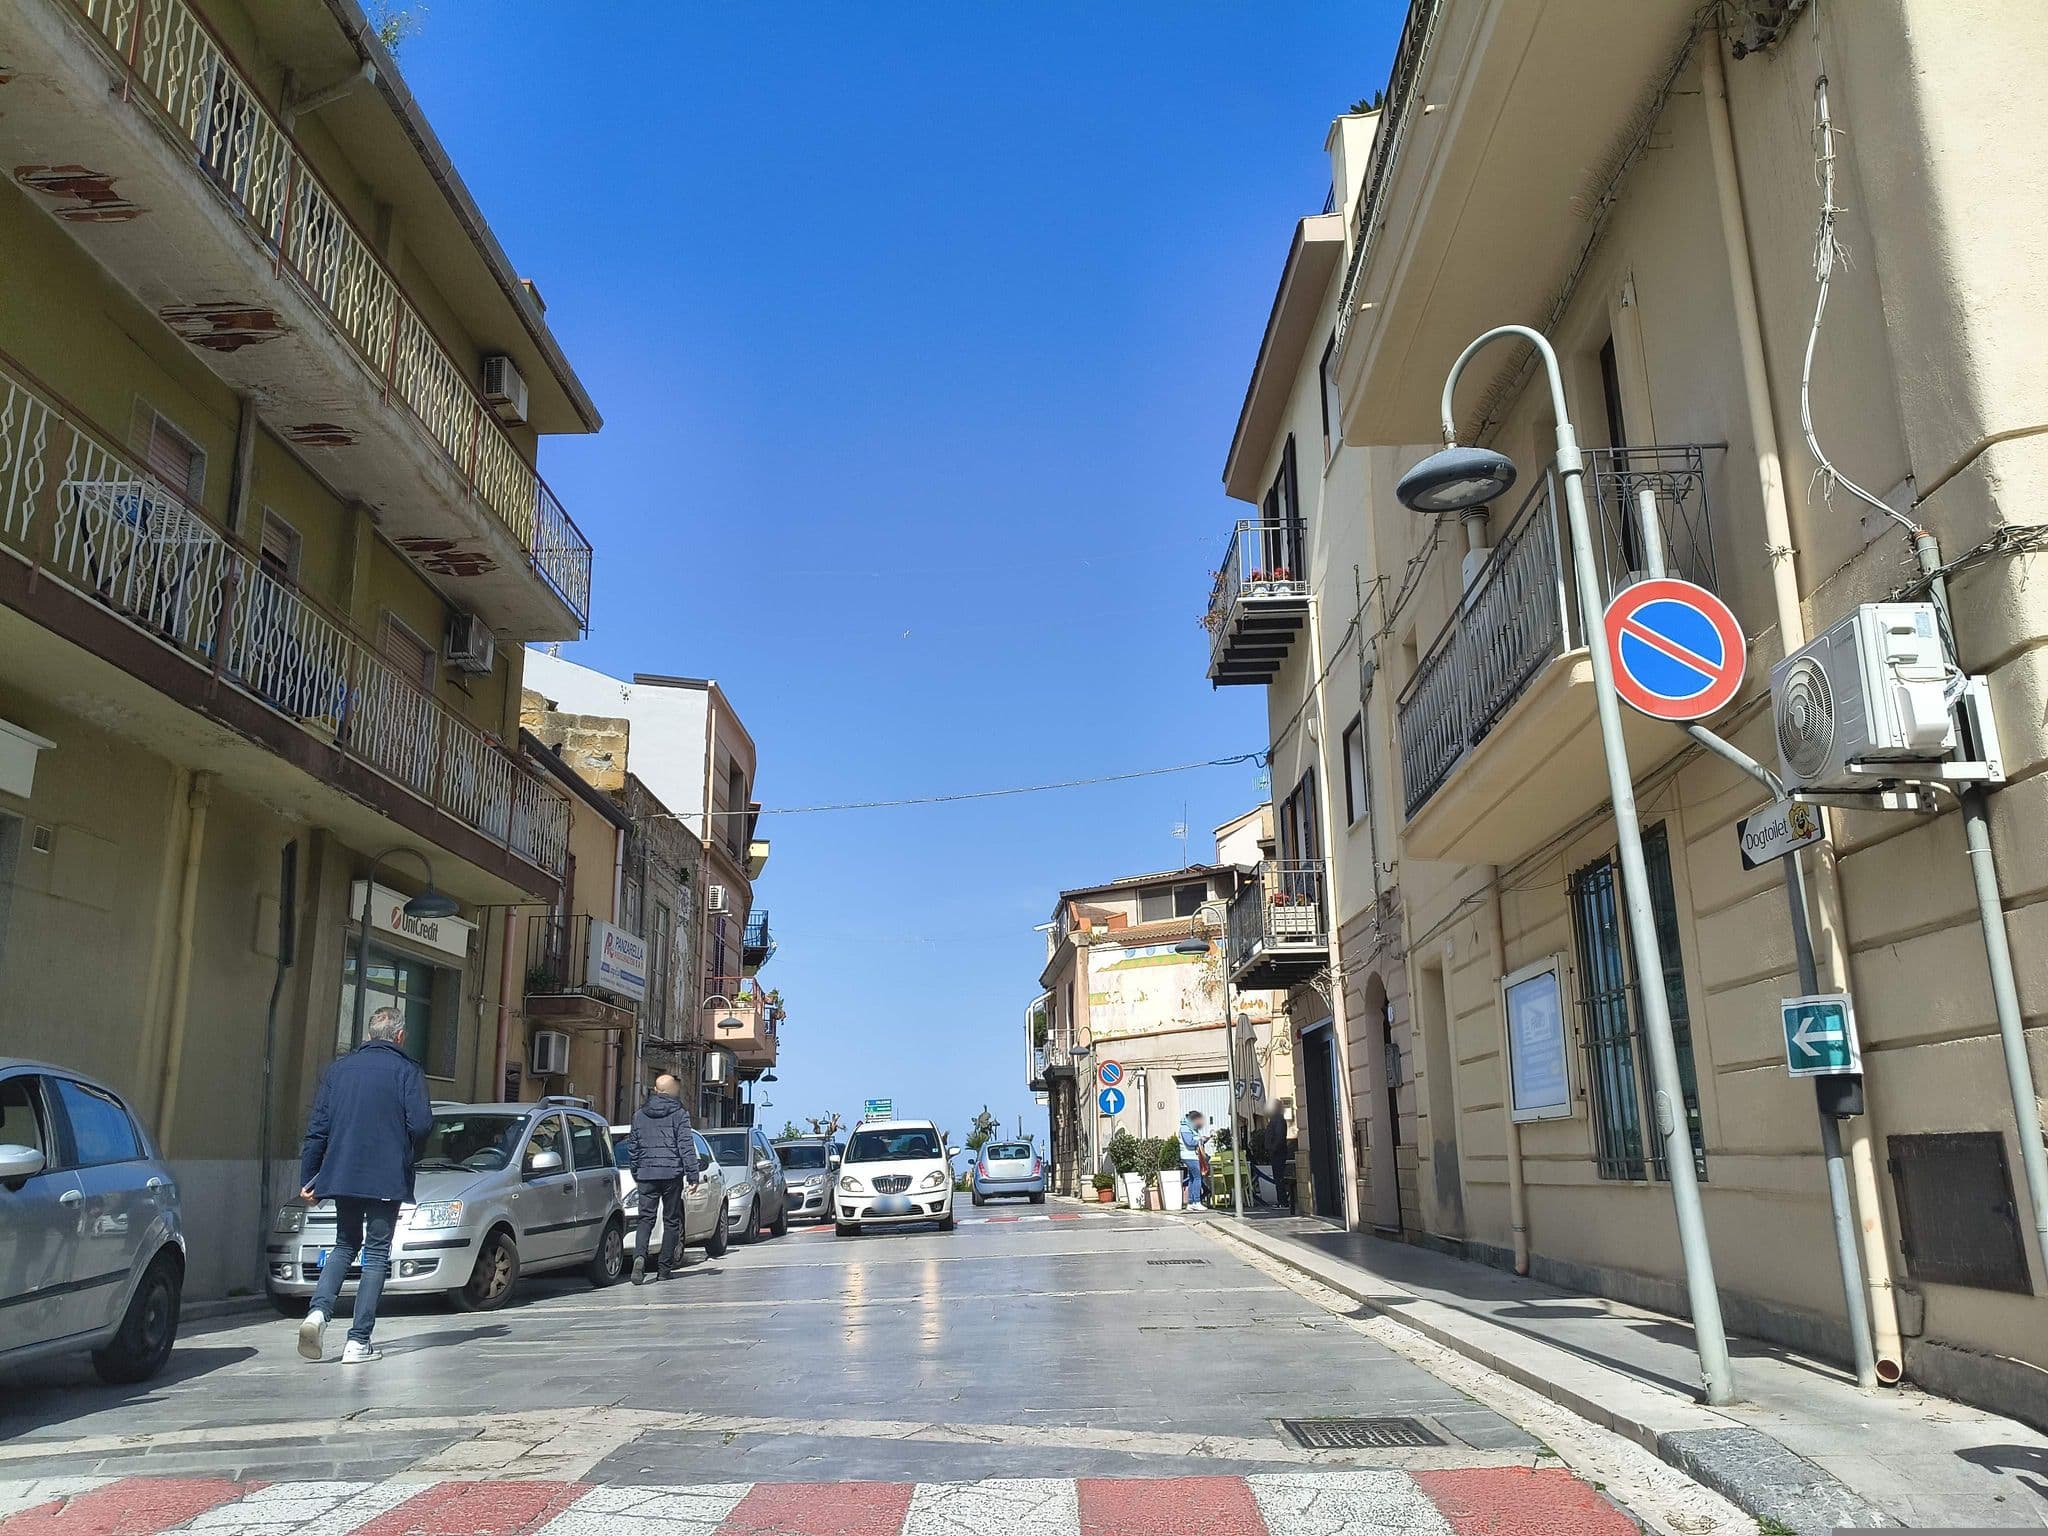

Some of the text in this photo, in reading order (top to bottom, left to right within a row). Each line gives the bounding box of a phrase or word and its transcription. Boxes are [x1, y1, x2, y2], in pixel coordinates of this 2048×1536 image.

[1745, 818, 1788, 850] Dogtoilet
[402, 912, 439, 942] UniCredit
[615, 936, 644, 960] PANZARELLA
